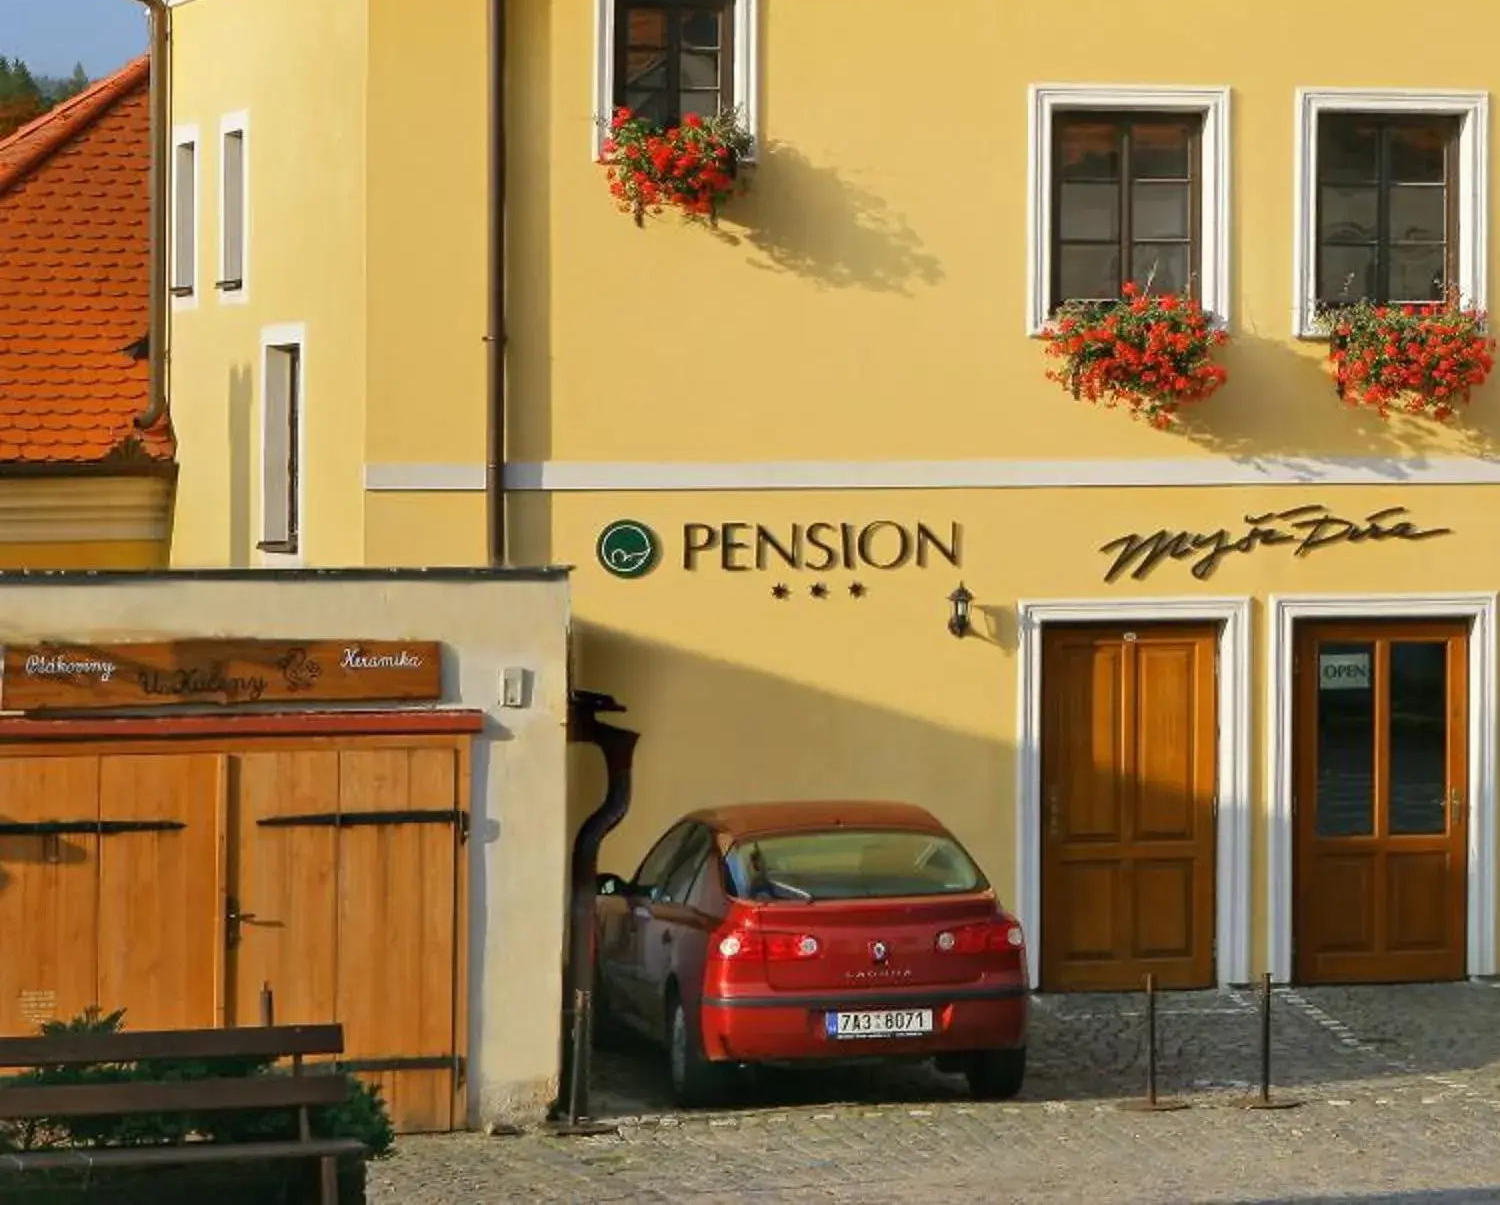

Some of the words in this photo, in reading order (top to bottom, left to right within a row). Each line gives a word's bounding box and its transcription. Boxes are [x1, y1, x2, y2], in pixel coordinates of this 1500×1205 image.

[683, 520, 963, 571] PENSION
[1323, 663, 1367, 680] OPEN
[841, 1014, 871, 1031] 7A3
